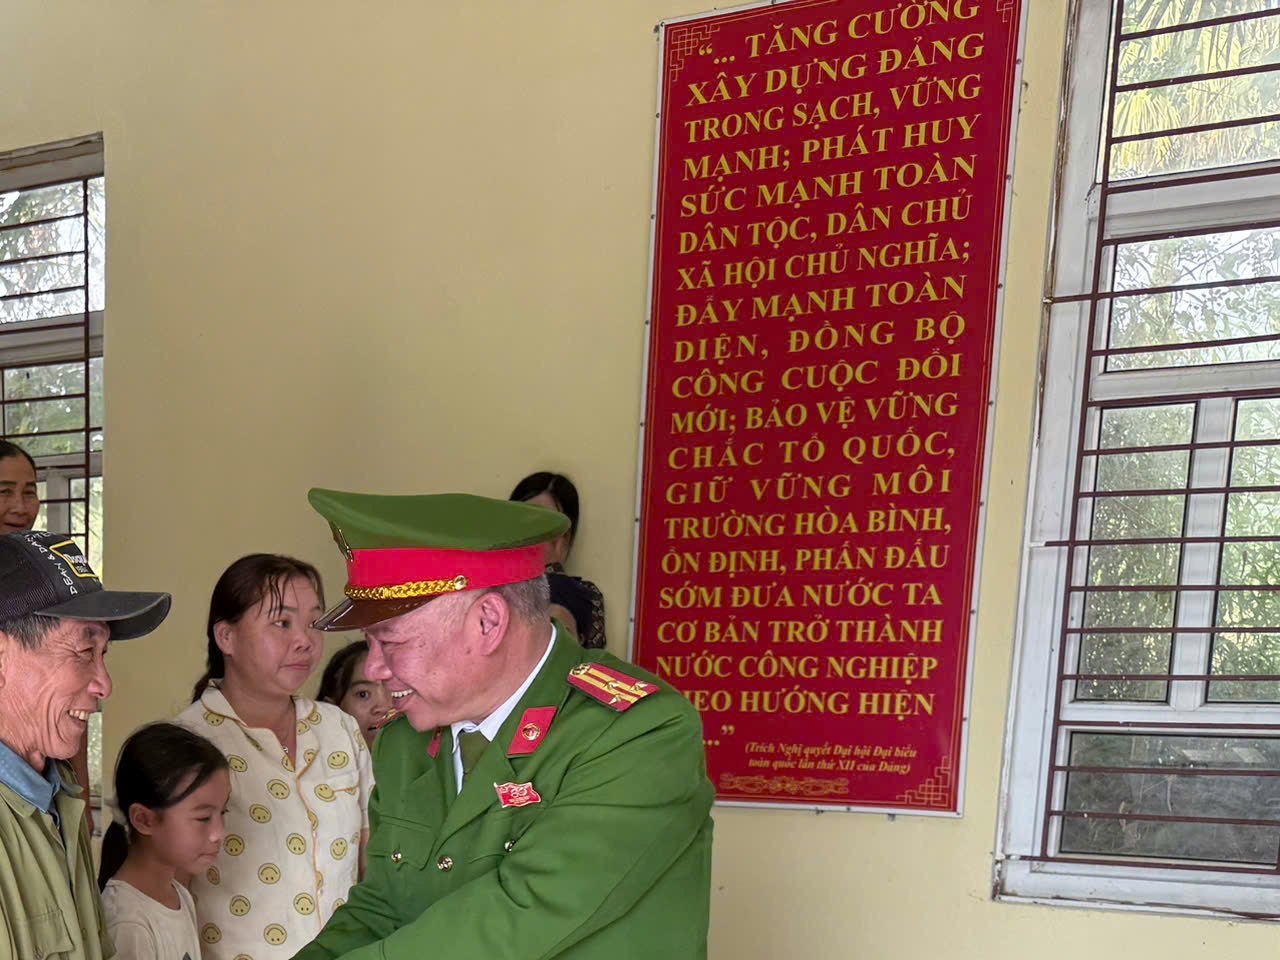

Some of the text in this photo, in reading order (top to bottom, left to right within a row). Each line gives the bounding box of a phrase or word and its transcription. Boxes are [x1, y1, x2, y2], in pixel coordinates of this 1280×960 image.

[745, 19, 838, 60] TĂNG
[848, 0, 980, 39] CƯỜNG
[686, 33, 985, 107] XÂY DỰNG ĐẢNG
[685, 74, 982, 143] TRONG SẠCH, VỮNG
[682, 113, 982, 183] MẠNH; PHÁT HUY
[680, 152, 978, 218] SỨC MẠNH TOÀN
[679, 187, 973, 255] DÂN TỘC, DÂN CHỦ
[676, 232, 971, 292] XÃ HỘI CHỦ NGHĨA;
[675, 271, 967, 328] ĐẨY MẠNH TOÀN
[674, 310, 966, 365] DIỆN, ĐỒNG BỘ
[672, 347, 963, 399] CÔNG CUỘC ĐỔI
[671, 388, 959, 435] MỚI; BẢO VỆ VỮNG
[668, 426, 956, 470] CHẮC TỔ QUỐC,
[666, 464, 952, 505] GIỮ VỮNG MÔI
[664, 504, 952, 540] TRƯỜNG HÒA BÌNH,
[661, 537, 950, 580] ỔN ĐỊNH, PHẤN ĐẤU
[659, 577, 943, 609] SỚM ĐƯA NƯỚC TA
[656, 612, 944, 644] CƠ BẢN TRỞ THÀNH
[655, 649, 939, 685] NƯỚC CÔNG NGHIỆP
[739, 688, 850, 716] HƯỚNG
[857, 690, 936, 721] HIỆN
